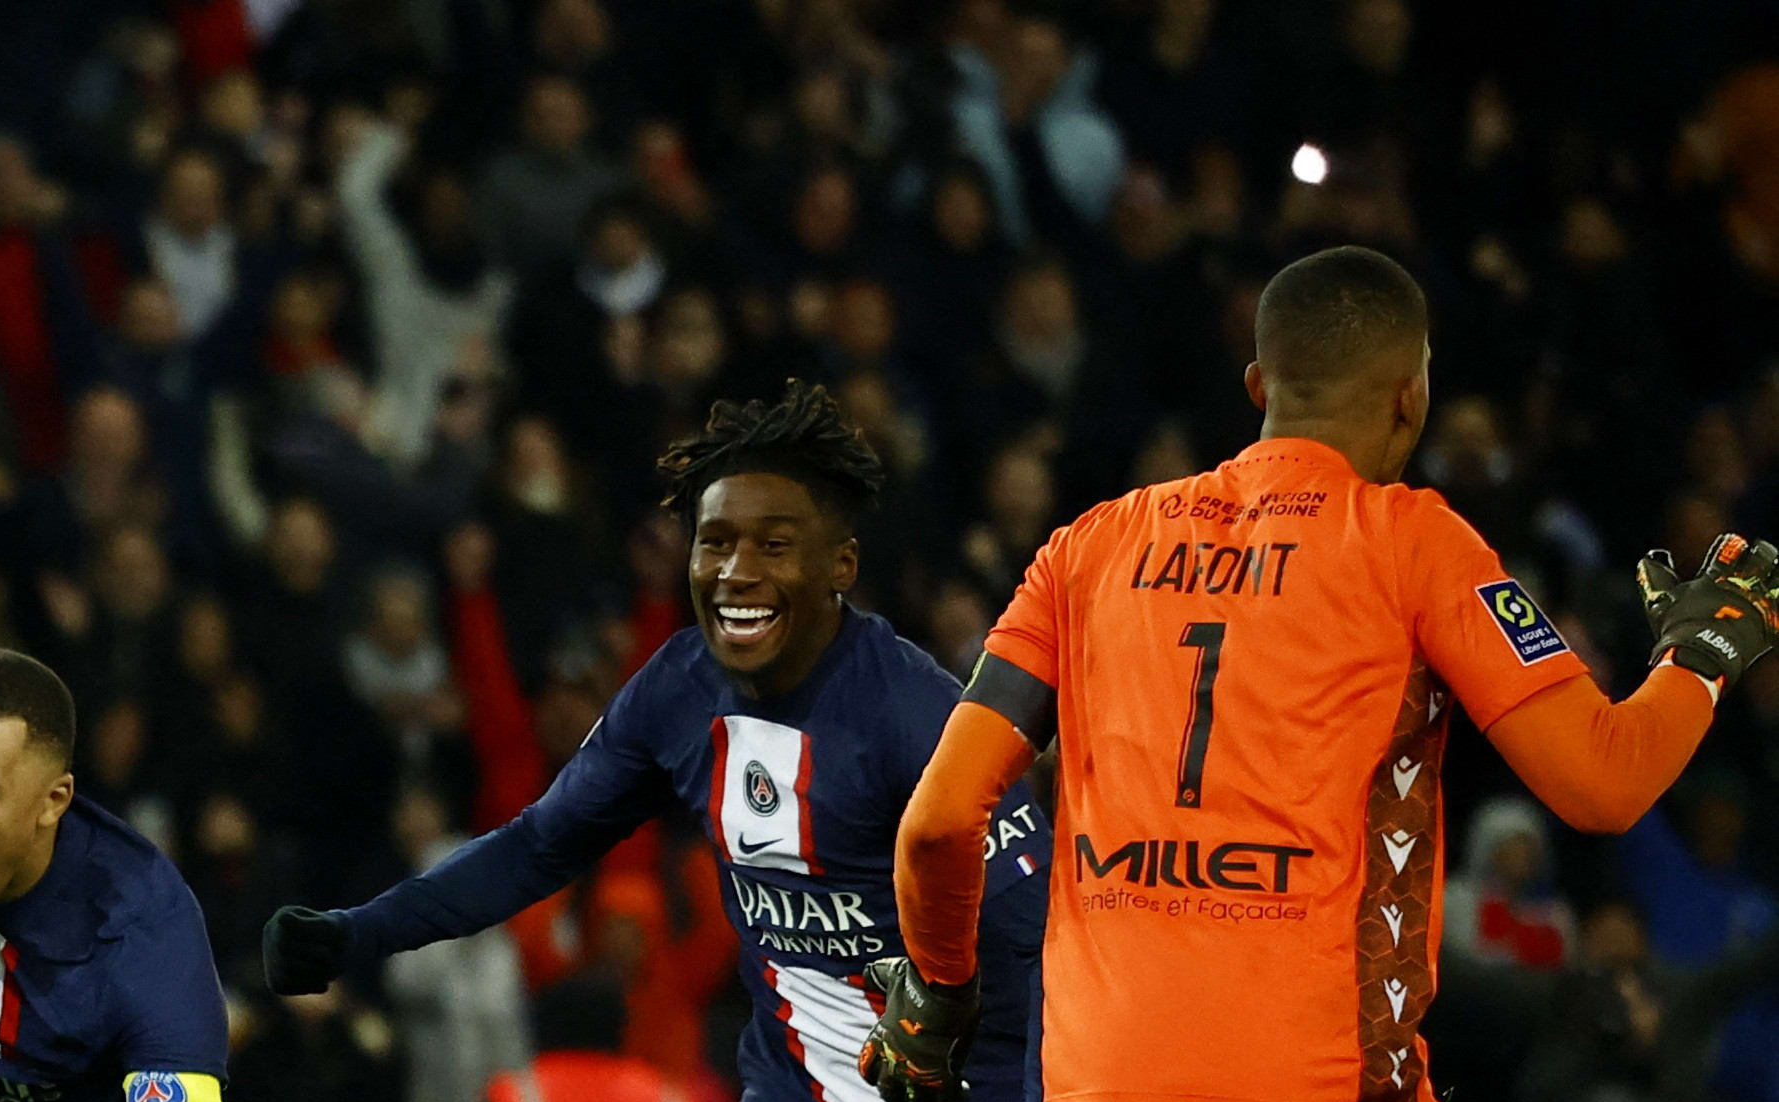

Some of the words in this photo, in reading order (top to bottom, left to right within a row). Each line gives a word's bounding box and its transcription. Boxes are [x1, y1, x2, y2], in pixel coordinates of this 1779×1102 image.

[1189, 505, 1219, 520] DU
[1130, 542, 1299, 597] LAFONT
[1695, 628, 1738, 660] ALBAN
[1174, 622, 1227, 809] 1
[1074, 833, 1315, 894] MILLET
[730, 870, 876, 932] QATAR
[1166, 895, 1190, 917] et
